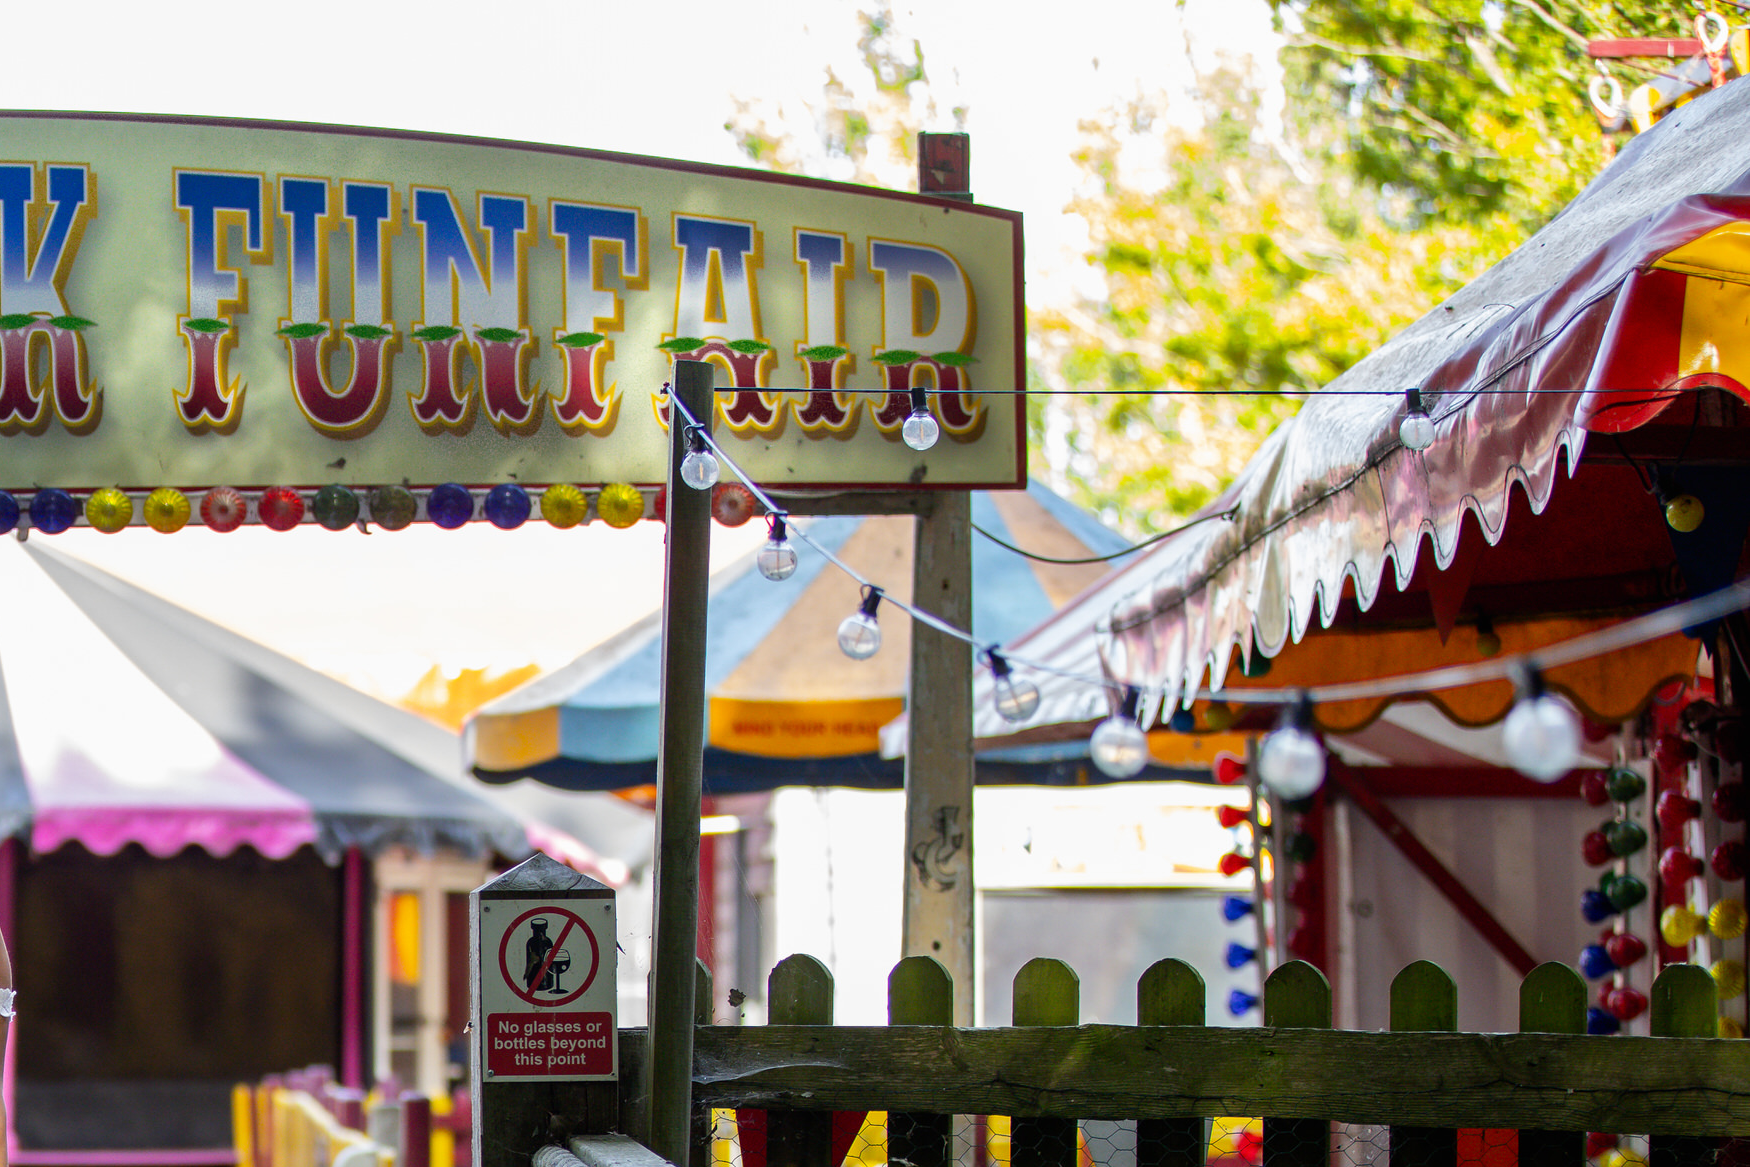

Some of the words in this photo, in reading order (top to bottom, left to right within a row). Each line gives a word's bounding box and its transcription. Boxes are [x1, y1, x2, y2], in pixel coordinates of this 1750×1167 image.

[171, 165, 988, 438] FUNFAIR
[498, 1021, 519, 1033] No
[524, 1020, 581, 1035] glasses
[585, 1022, 602, 1032] or
[494, 1036, 545, 1049] bottles
[550, 1036, 606, 1052] beyond
[514, 1053, 543, 1065] this
[547, 1052, 586, 1068] point
